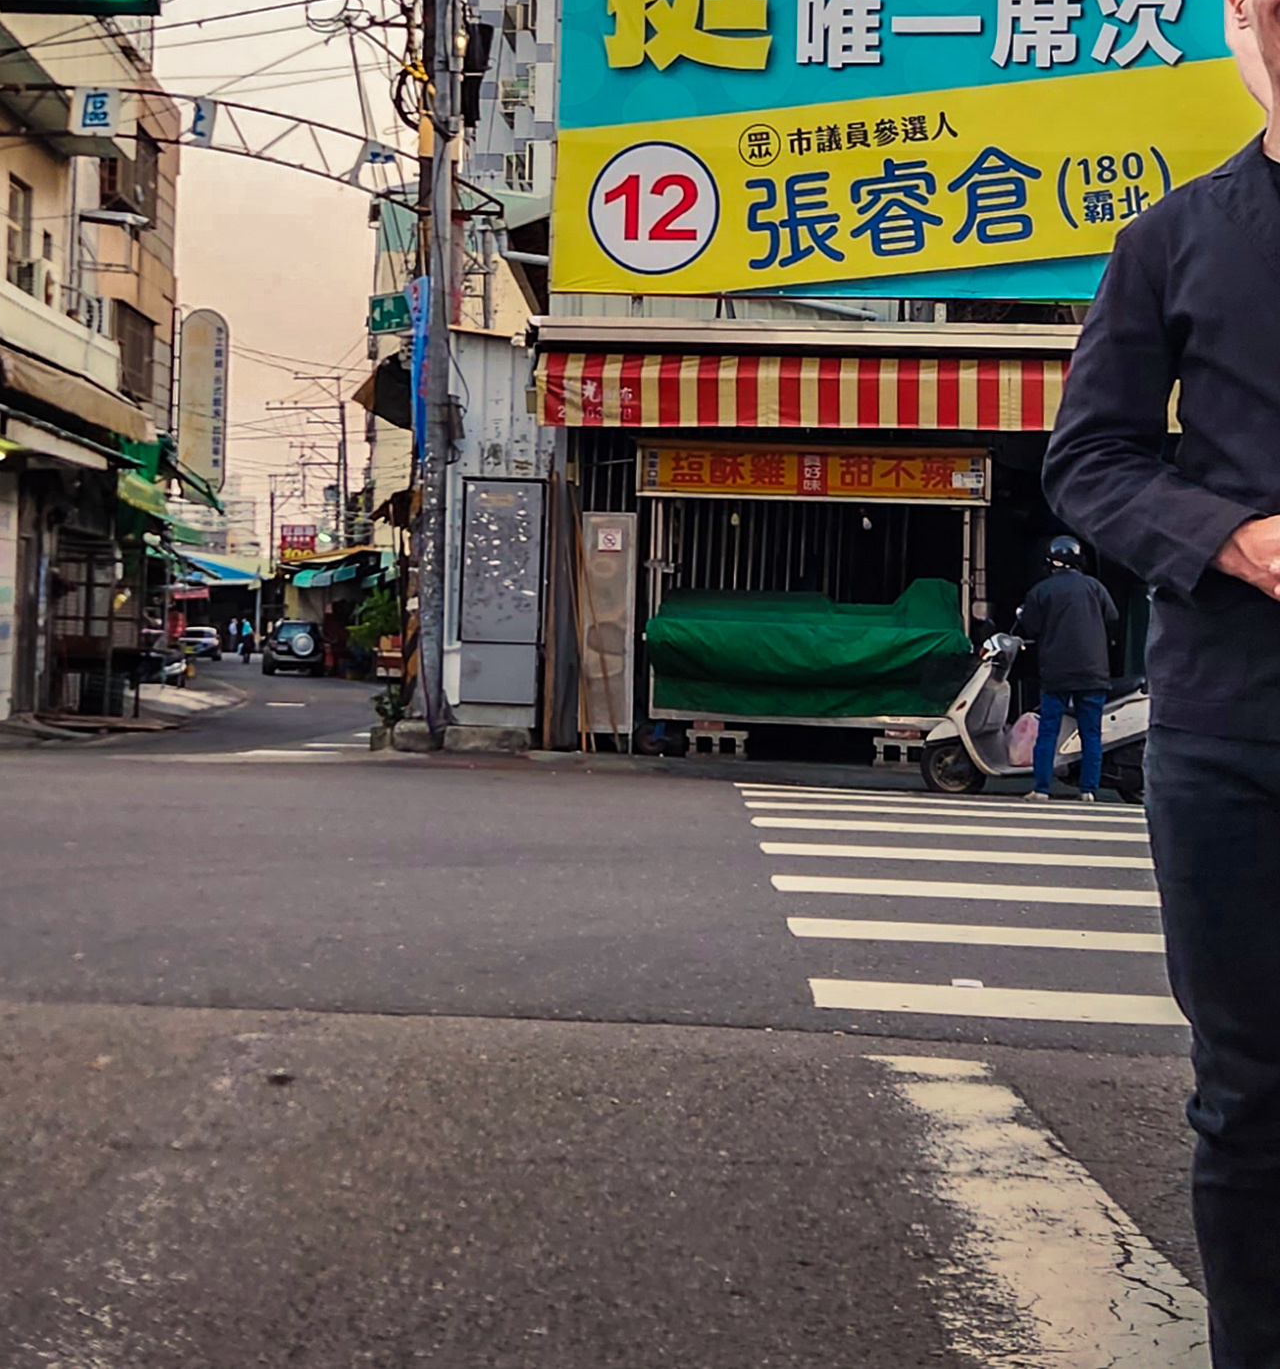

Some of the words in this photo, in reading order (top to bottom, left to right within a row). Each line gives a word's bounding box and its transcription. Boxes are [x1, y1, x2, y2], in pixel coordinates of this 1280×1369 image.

[787, 111, 958, 156] 市議員參選人
[603, 174, 698, 242] 12
[745, 146, 1042, 271] 張睿倉
[671, 451, 785, 486] 塩酥雞
[840, 455, 957, 489] 甜不辣
